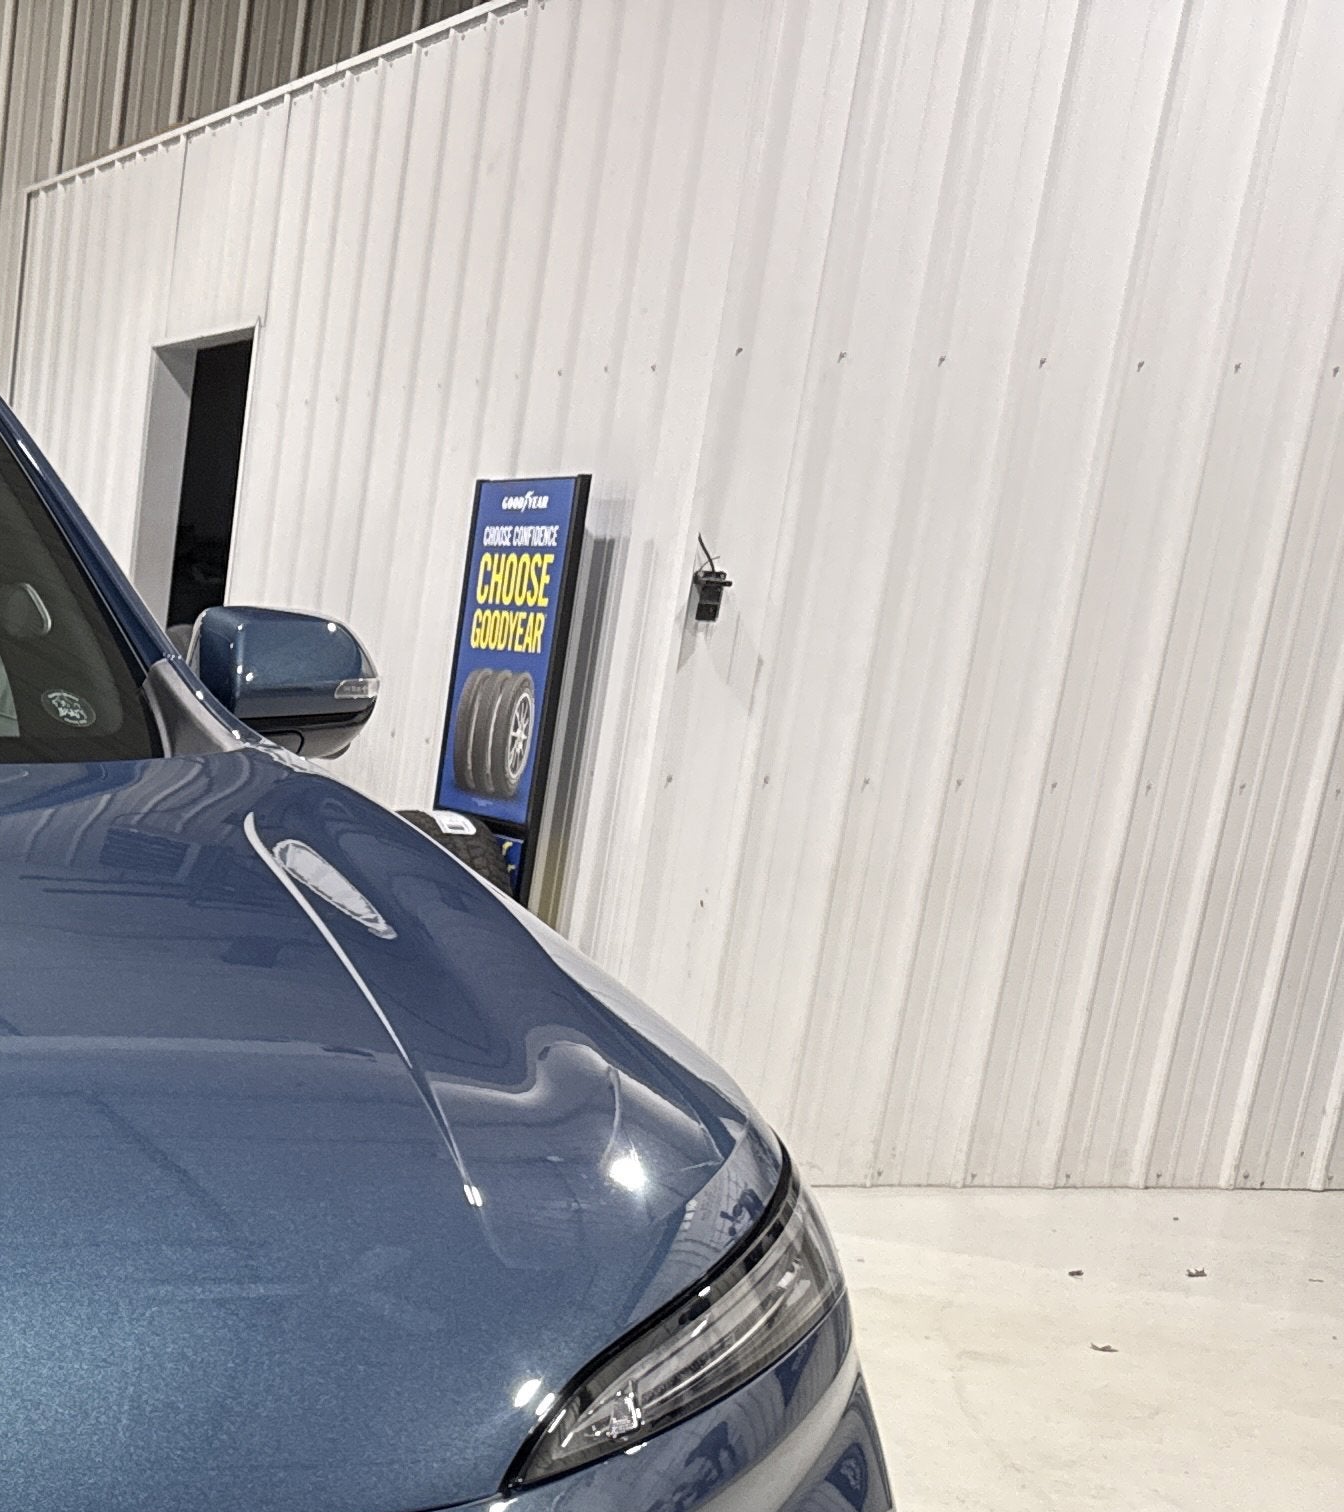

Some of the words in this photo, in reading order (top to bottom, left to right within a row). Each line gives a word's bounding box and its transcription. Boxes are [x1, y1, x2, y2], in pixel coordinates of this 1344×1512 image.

[501, 490, 550, 513] GOODYEAR
[482, 525, 513, 547] CHOOSE
[512, 525, 559, 547] CONFIDENCE
[476, 552, 555, 607] CHOOSE
[470, 608, 547, 654] GOODYEAR
